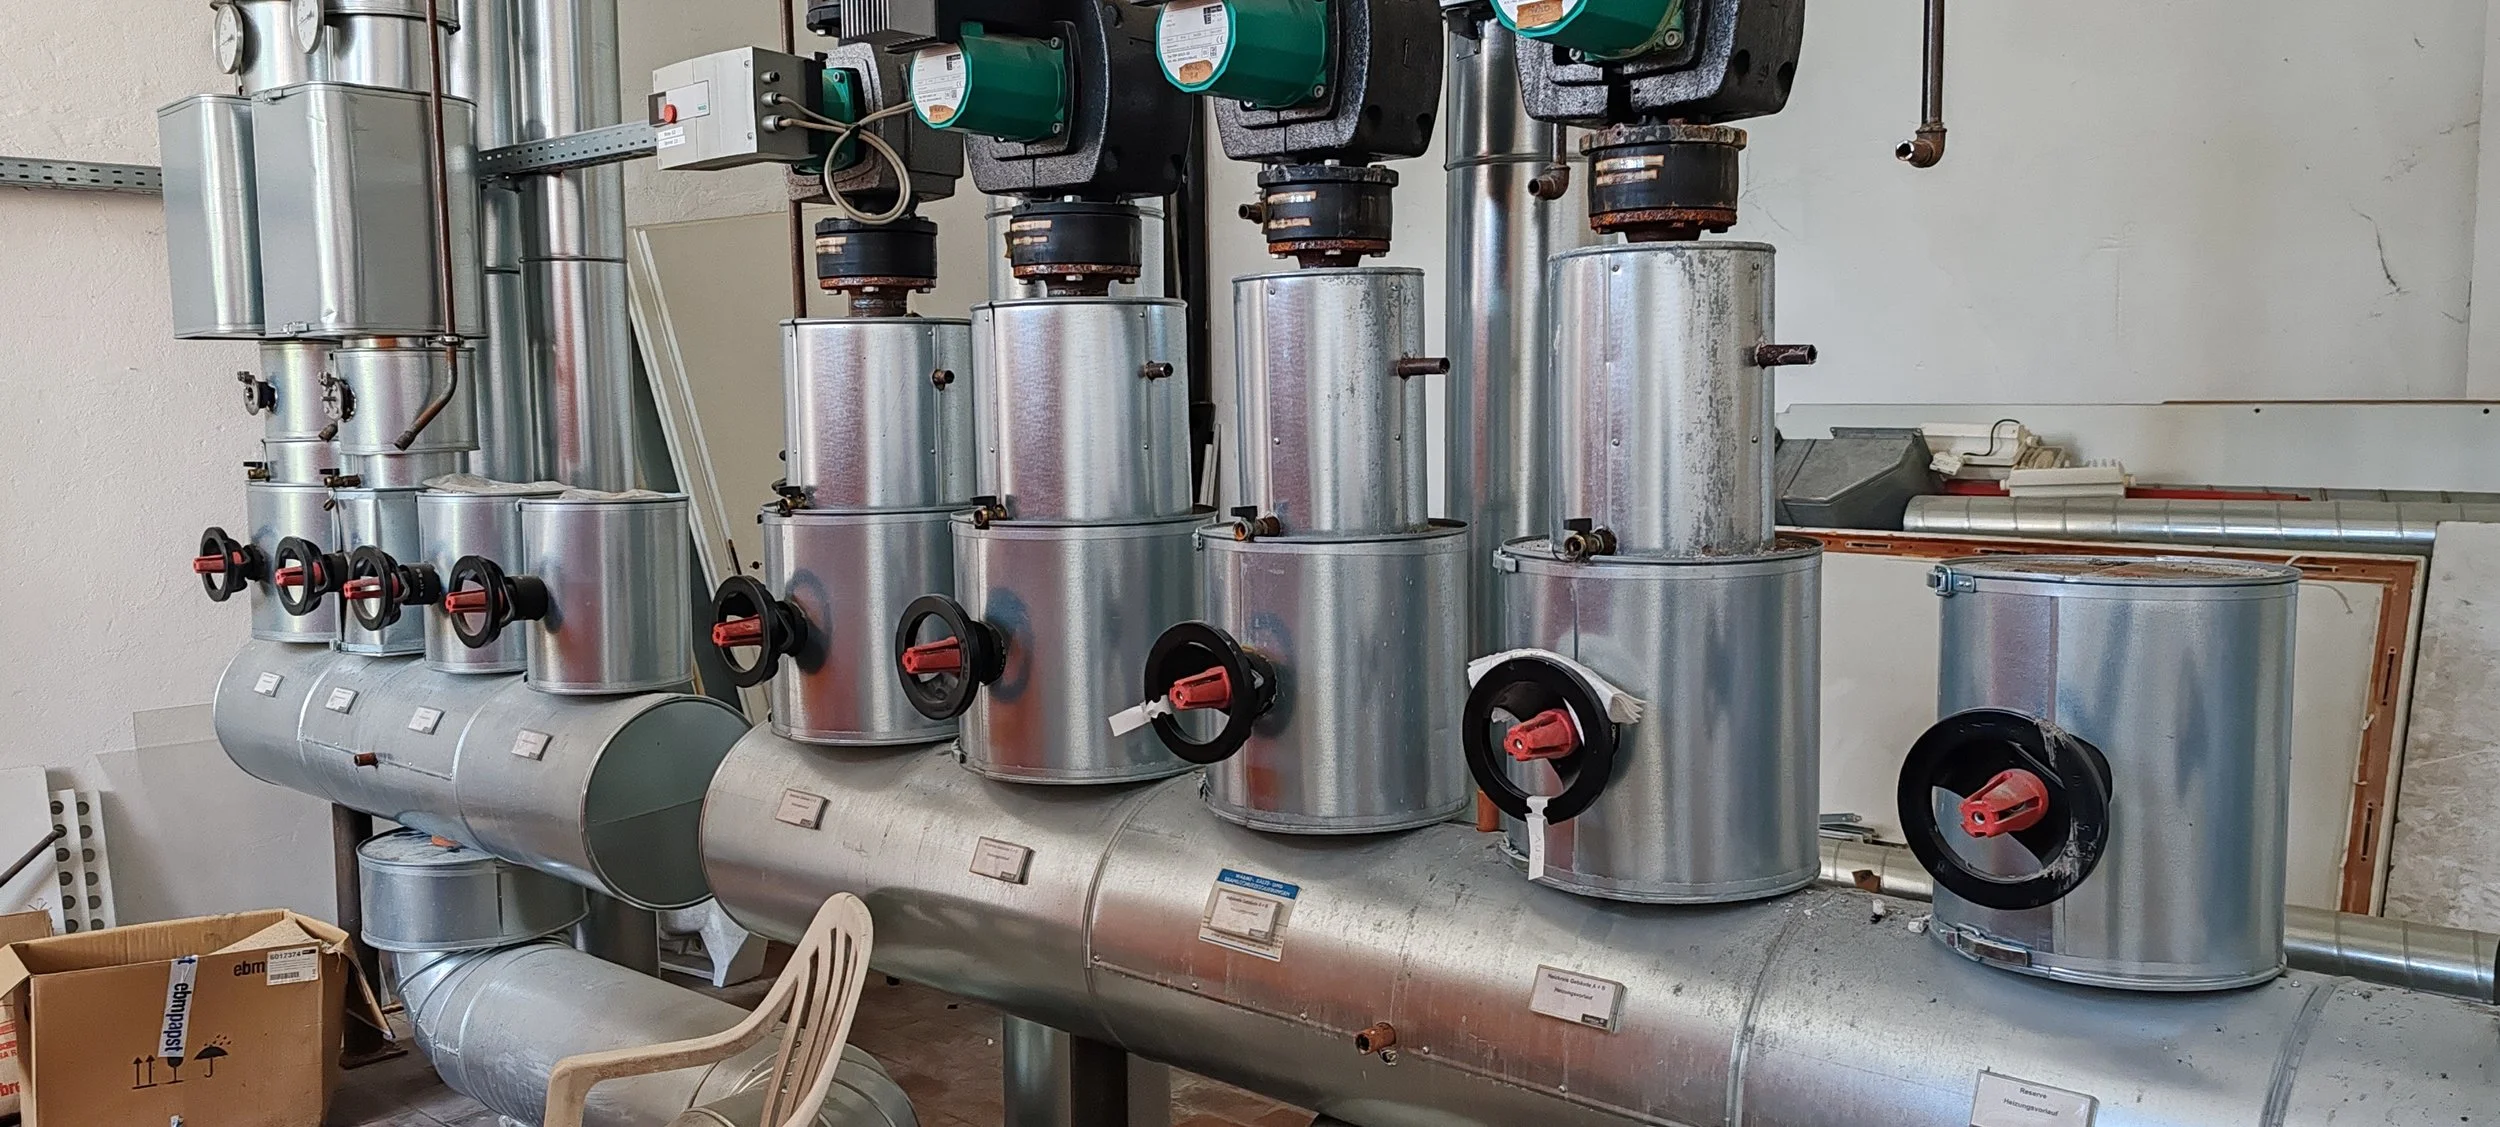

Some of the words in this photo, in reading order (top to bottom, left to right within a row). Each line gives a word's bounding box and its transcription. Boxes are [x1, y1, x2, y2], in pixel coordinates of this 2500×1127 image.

[233, 960, 265, 977] ebm
[163, 982, 192, 1052] ebmpapst
[2019, 1087, 2047, 1099] Reserve
[2003, 1097, 2060, 1117] Heizungsvorlauf
